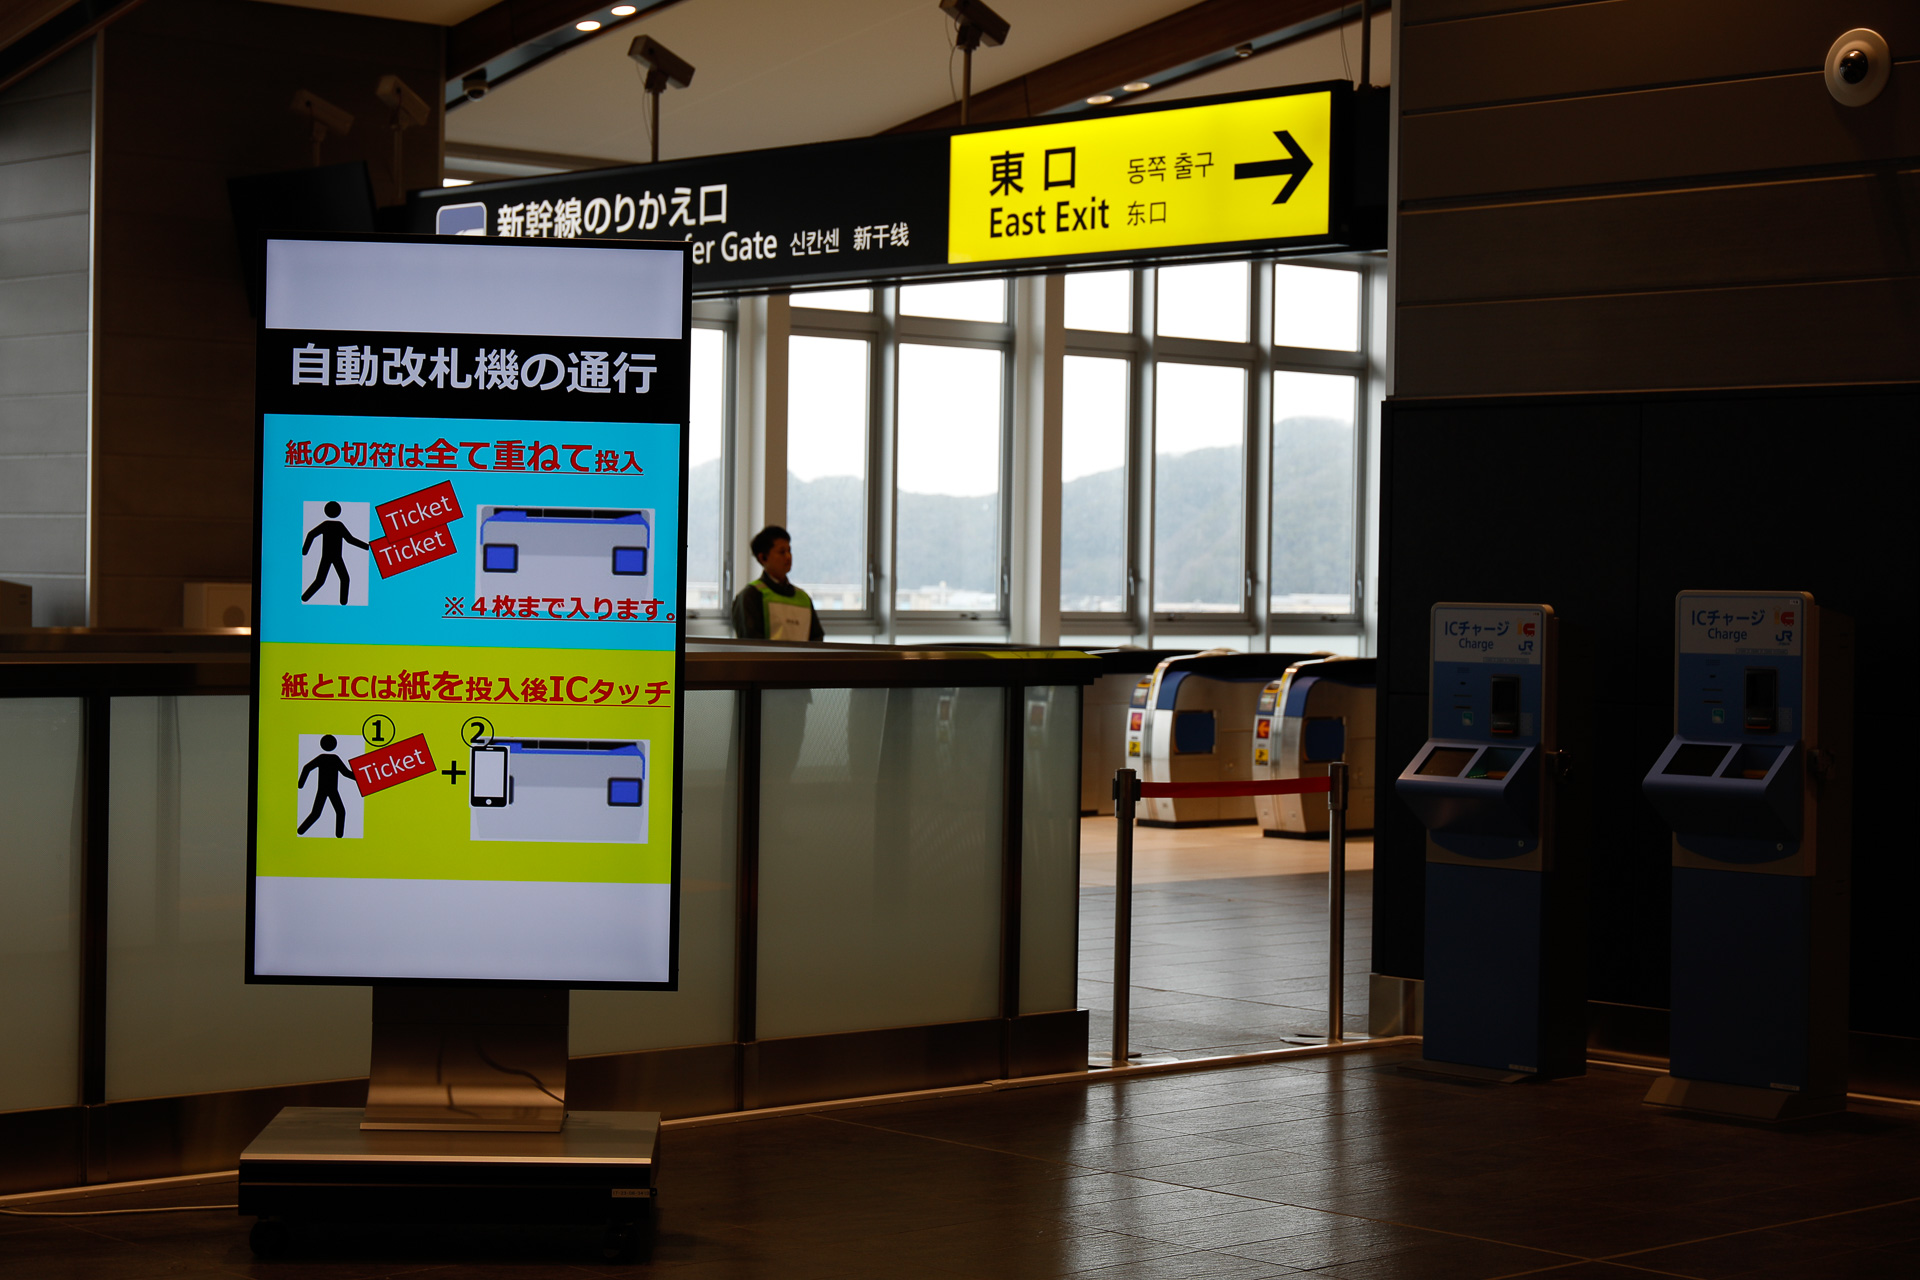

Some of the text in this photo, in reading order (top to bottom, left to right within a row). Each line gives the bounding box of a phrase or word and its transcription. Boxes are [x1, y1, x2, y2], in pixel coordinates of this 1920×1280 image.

[1127, 151, 1215, 185] 동쪽 출구
[497, 183, 728, 238] 新幹線のりかえ口
[989, 196, 1110, 239] East Exit
[1127, 200, 1167, 226] 东口
[720, 230, 778, 262] Gate
[789, 227, 840, 257] 신칸센
[853, 221, 910, 251] 新干线
[292, 343, 658, 394] 自動改札機の通行
[285, 438, 643, 473] 紙の切符は全て重ねて投入
[385, 494, 453, 533] Ticket
[379, 529, 446, 568] Ticket
[1444, 621, 1510, 637] ICチャージ
[1691, 609, 1766, 627] ICチャージ
[1458, 638, 1494, 652] Charge
[1518, 640, 1534, 652] JR
[1707, 628, 1748, 642] Charge
[1775, 630, 1793, 642] JR
[281, 669, 671, 705] 紙とICは紙を投入後ICタッチ
[358, 748, 427, 786] Ticket
